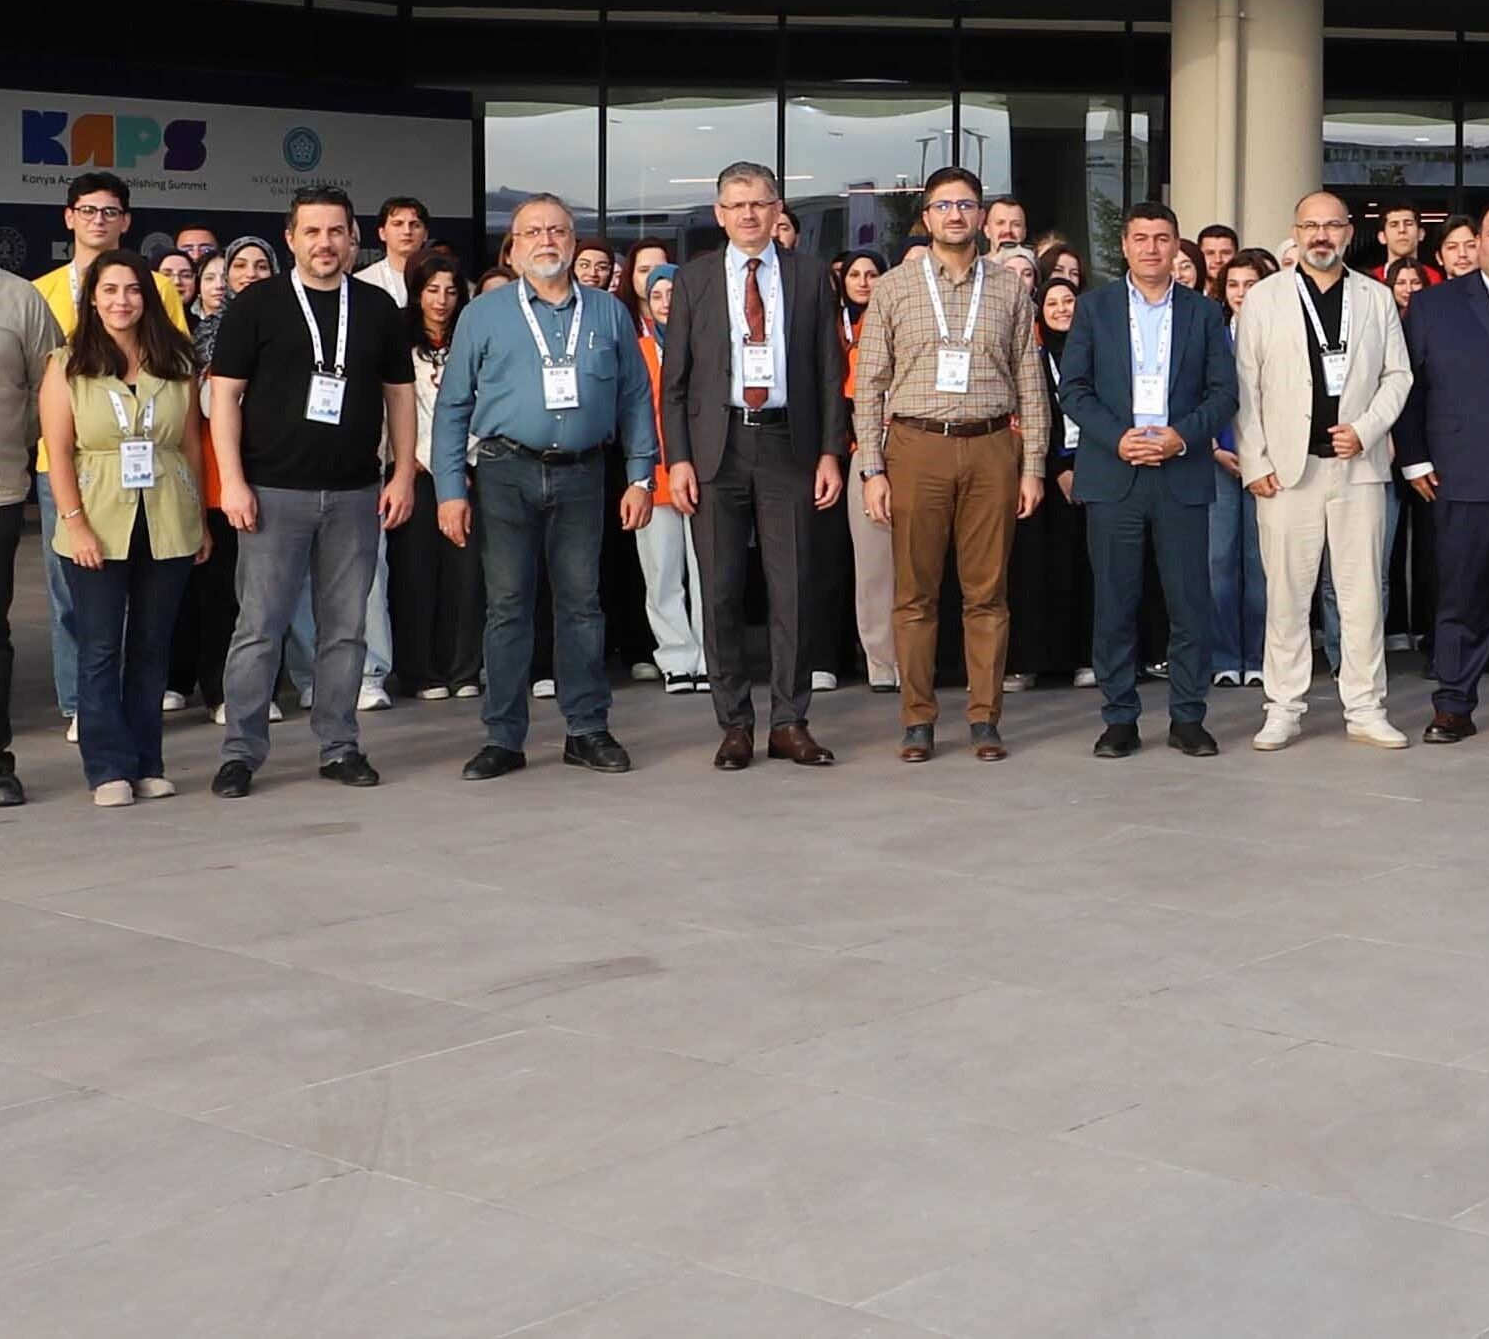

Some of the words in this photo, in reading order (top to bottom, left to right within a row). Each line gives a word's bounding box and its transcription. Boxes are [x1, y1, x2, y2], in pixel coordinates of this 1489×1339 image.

[21, 109, 208, 171] KAPS
[21, 173, 56, 186] Konya
[167, 178, 208, 191] Summit
